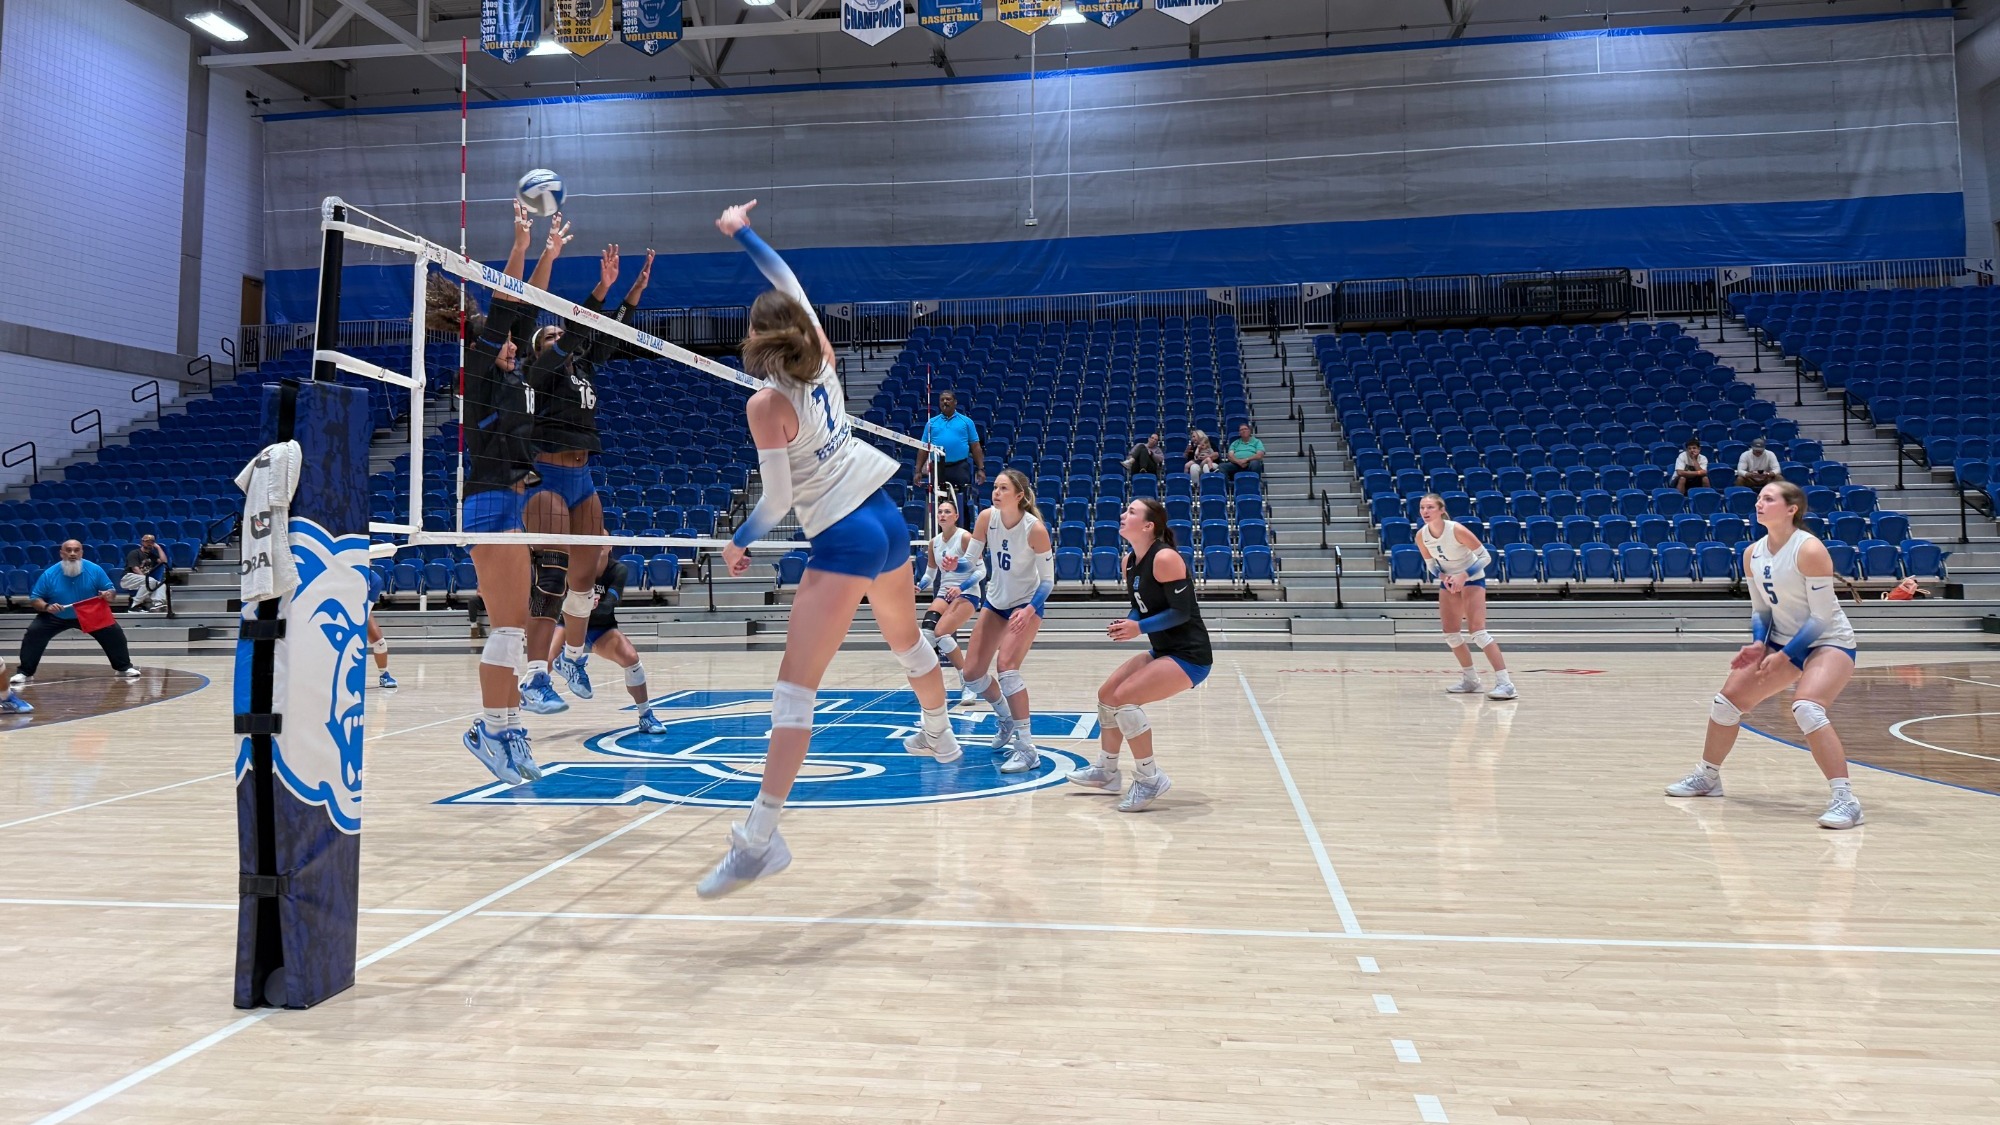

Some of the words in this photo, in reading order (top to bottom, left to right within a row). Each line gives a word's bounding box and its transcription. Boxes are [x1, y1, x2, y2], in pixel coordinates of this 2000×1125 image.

[844, 2, 902, 30] CHAMPIONS
[1079, 2, 1139, 12] BASKETBALL
[921, 12, 979, 25] BASKETBALL
[484, 40, 537, 50] VOLLEYBALL
[557, 33, 609, 44] VOLLEYBALL
[625, 31, 678, 42] VOLLEYBALL
[482, 265, 502, 286] SALT
[503, 274, 524, 295] LAKE
[1223, 289, 1232, 301] H
[841, 305, 849, 317] G
[636, 330, 650, 346] SALT
[650, 335, 665, 351] LAKE
[579, 385, 597, 410] 16
[811, 382, 835, 433] 7
[996, 551, 1011, 571] 16
[1133, 591, 1149, 614] 6
[1762, 582, 1779, 605] 5
